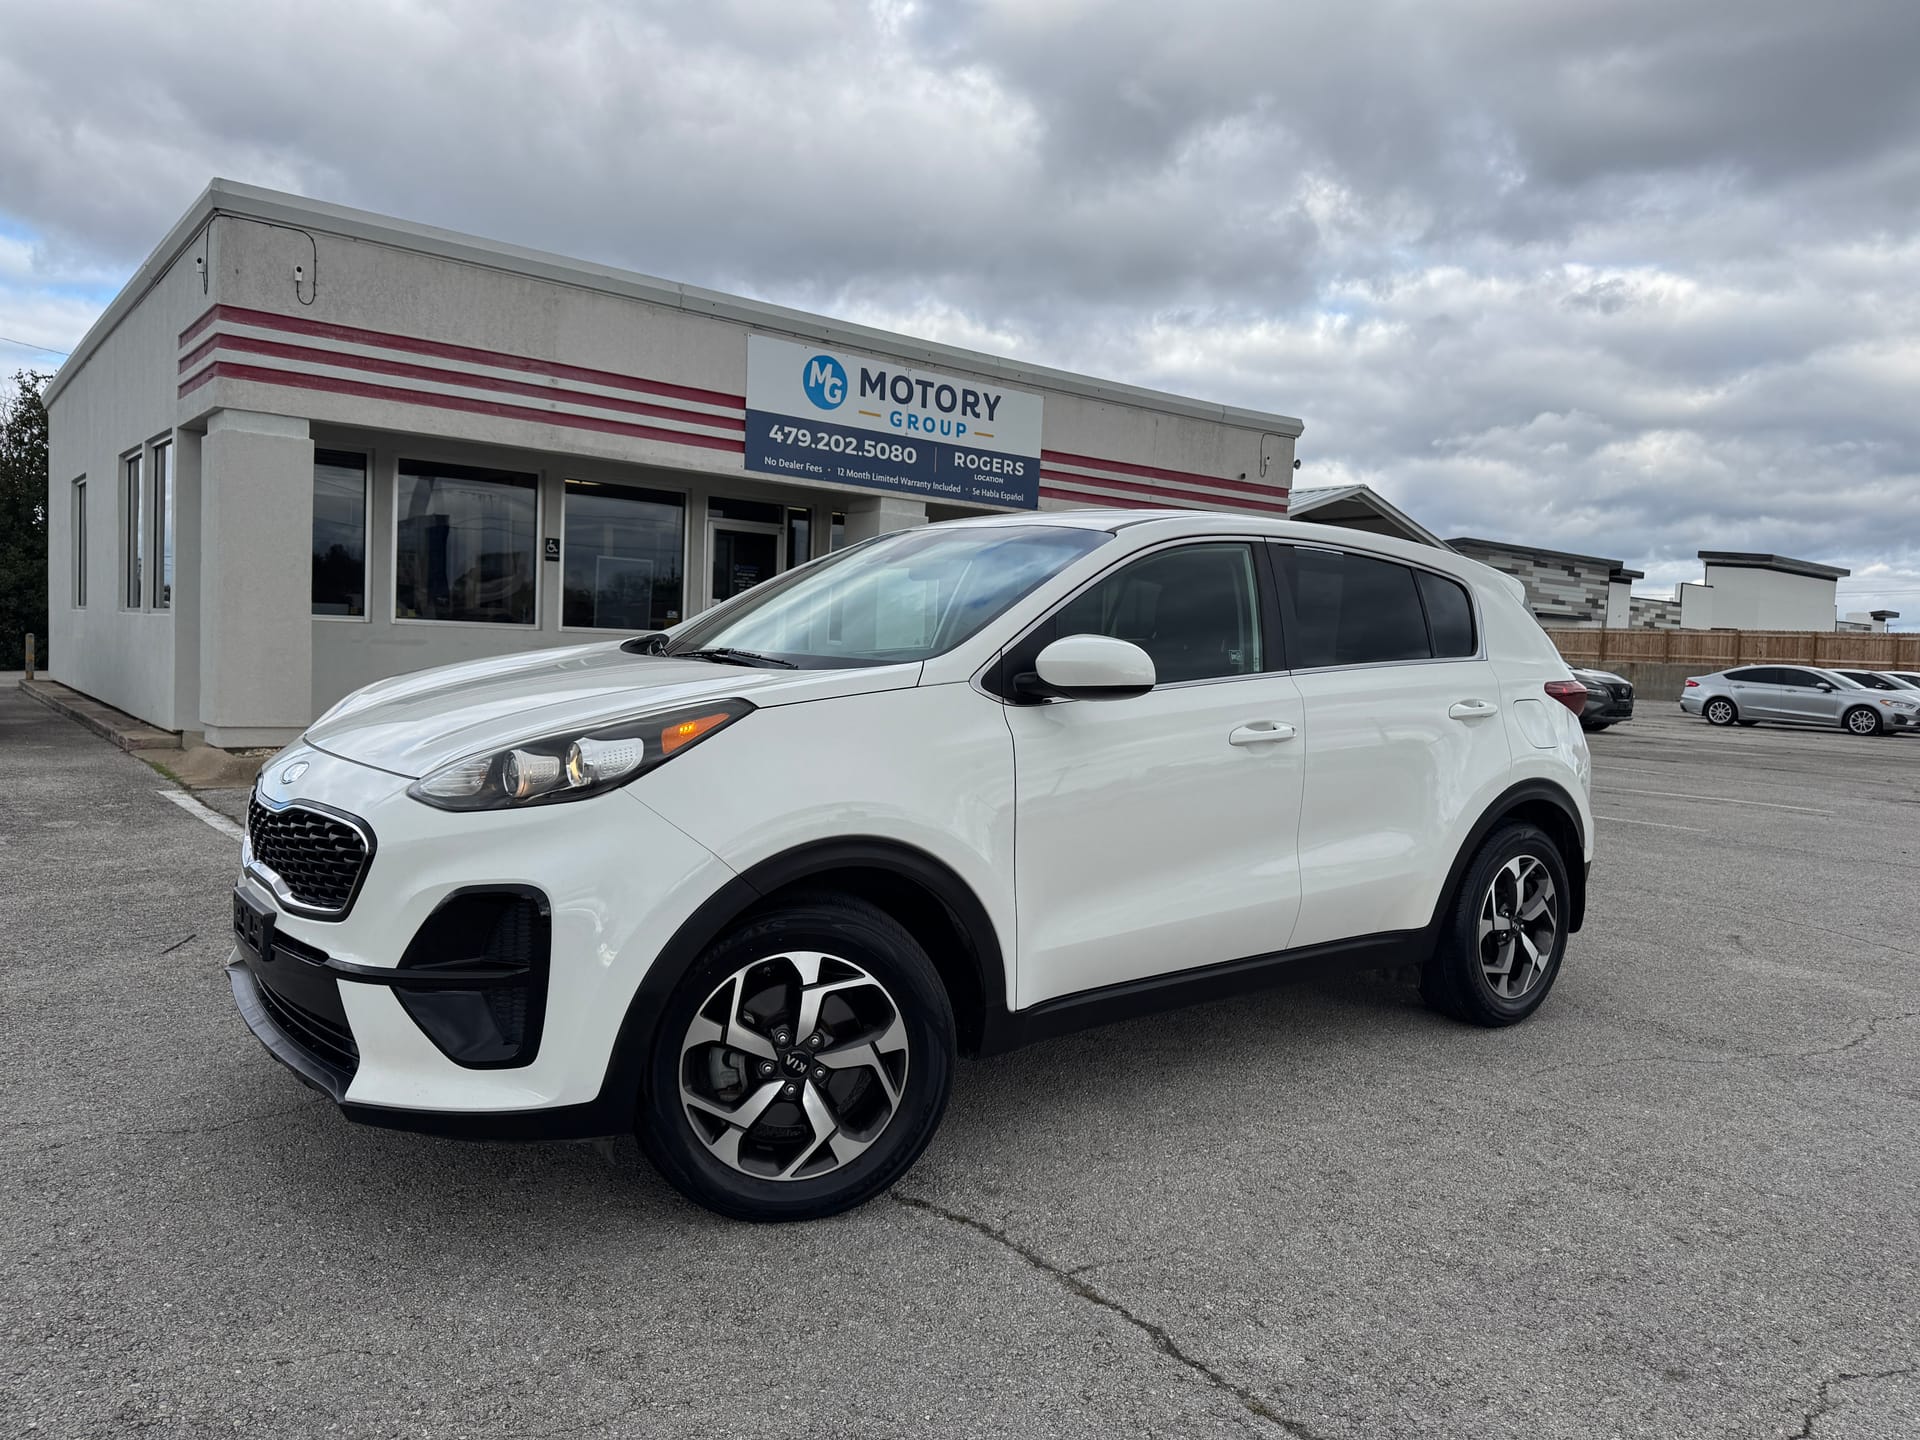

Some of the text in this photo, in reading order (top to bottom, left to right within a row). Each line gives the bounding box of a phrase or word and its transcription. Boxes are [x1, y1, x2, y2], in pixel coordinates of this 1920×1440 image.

[809, 360, 843, 404] MG
[860, 367, 1001, 421] MOTORY
[889, 410, 968, 438] GROUP
[769, 424, 917, 464] 479.202.5080
[764, 456, 823, 473] No Dealer Fees
[954, 452, 1025, 476] ROGERS
[837, 467, 961, 493] 12 Month Limited Warranty Included
[974, 474, 1004, 484] LOCATION
[972, 488, 1024, 502] Se Habla Español
[786, 1054, 807, 1073] KIA
